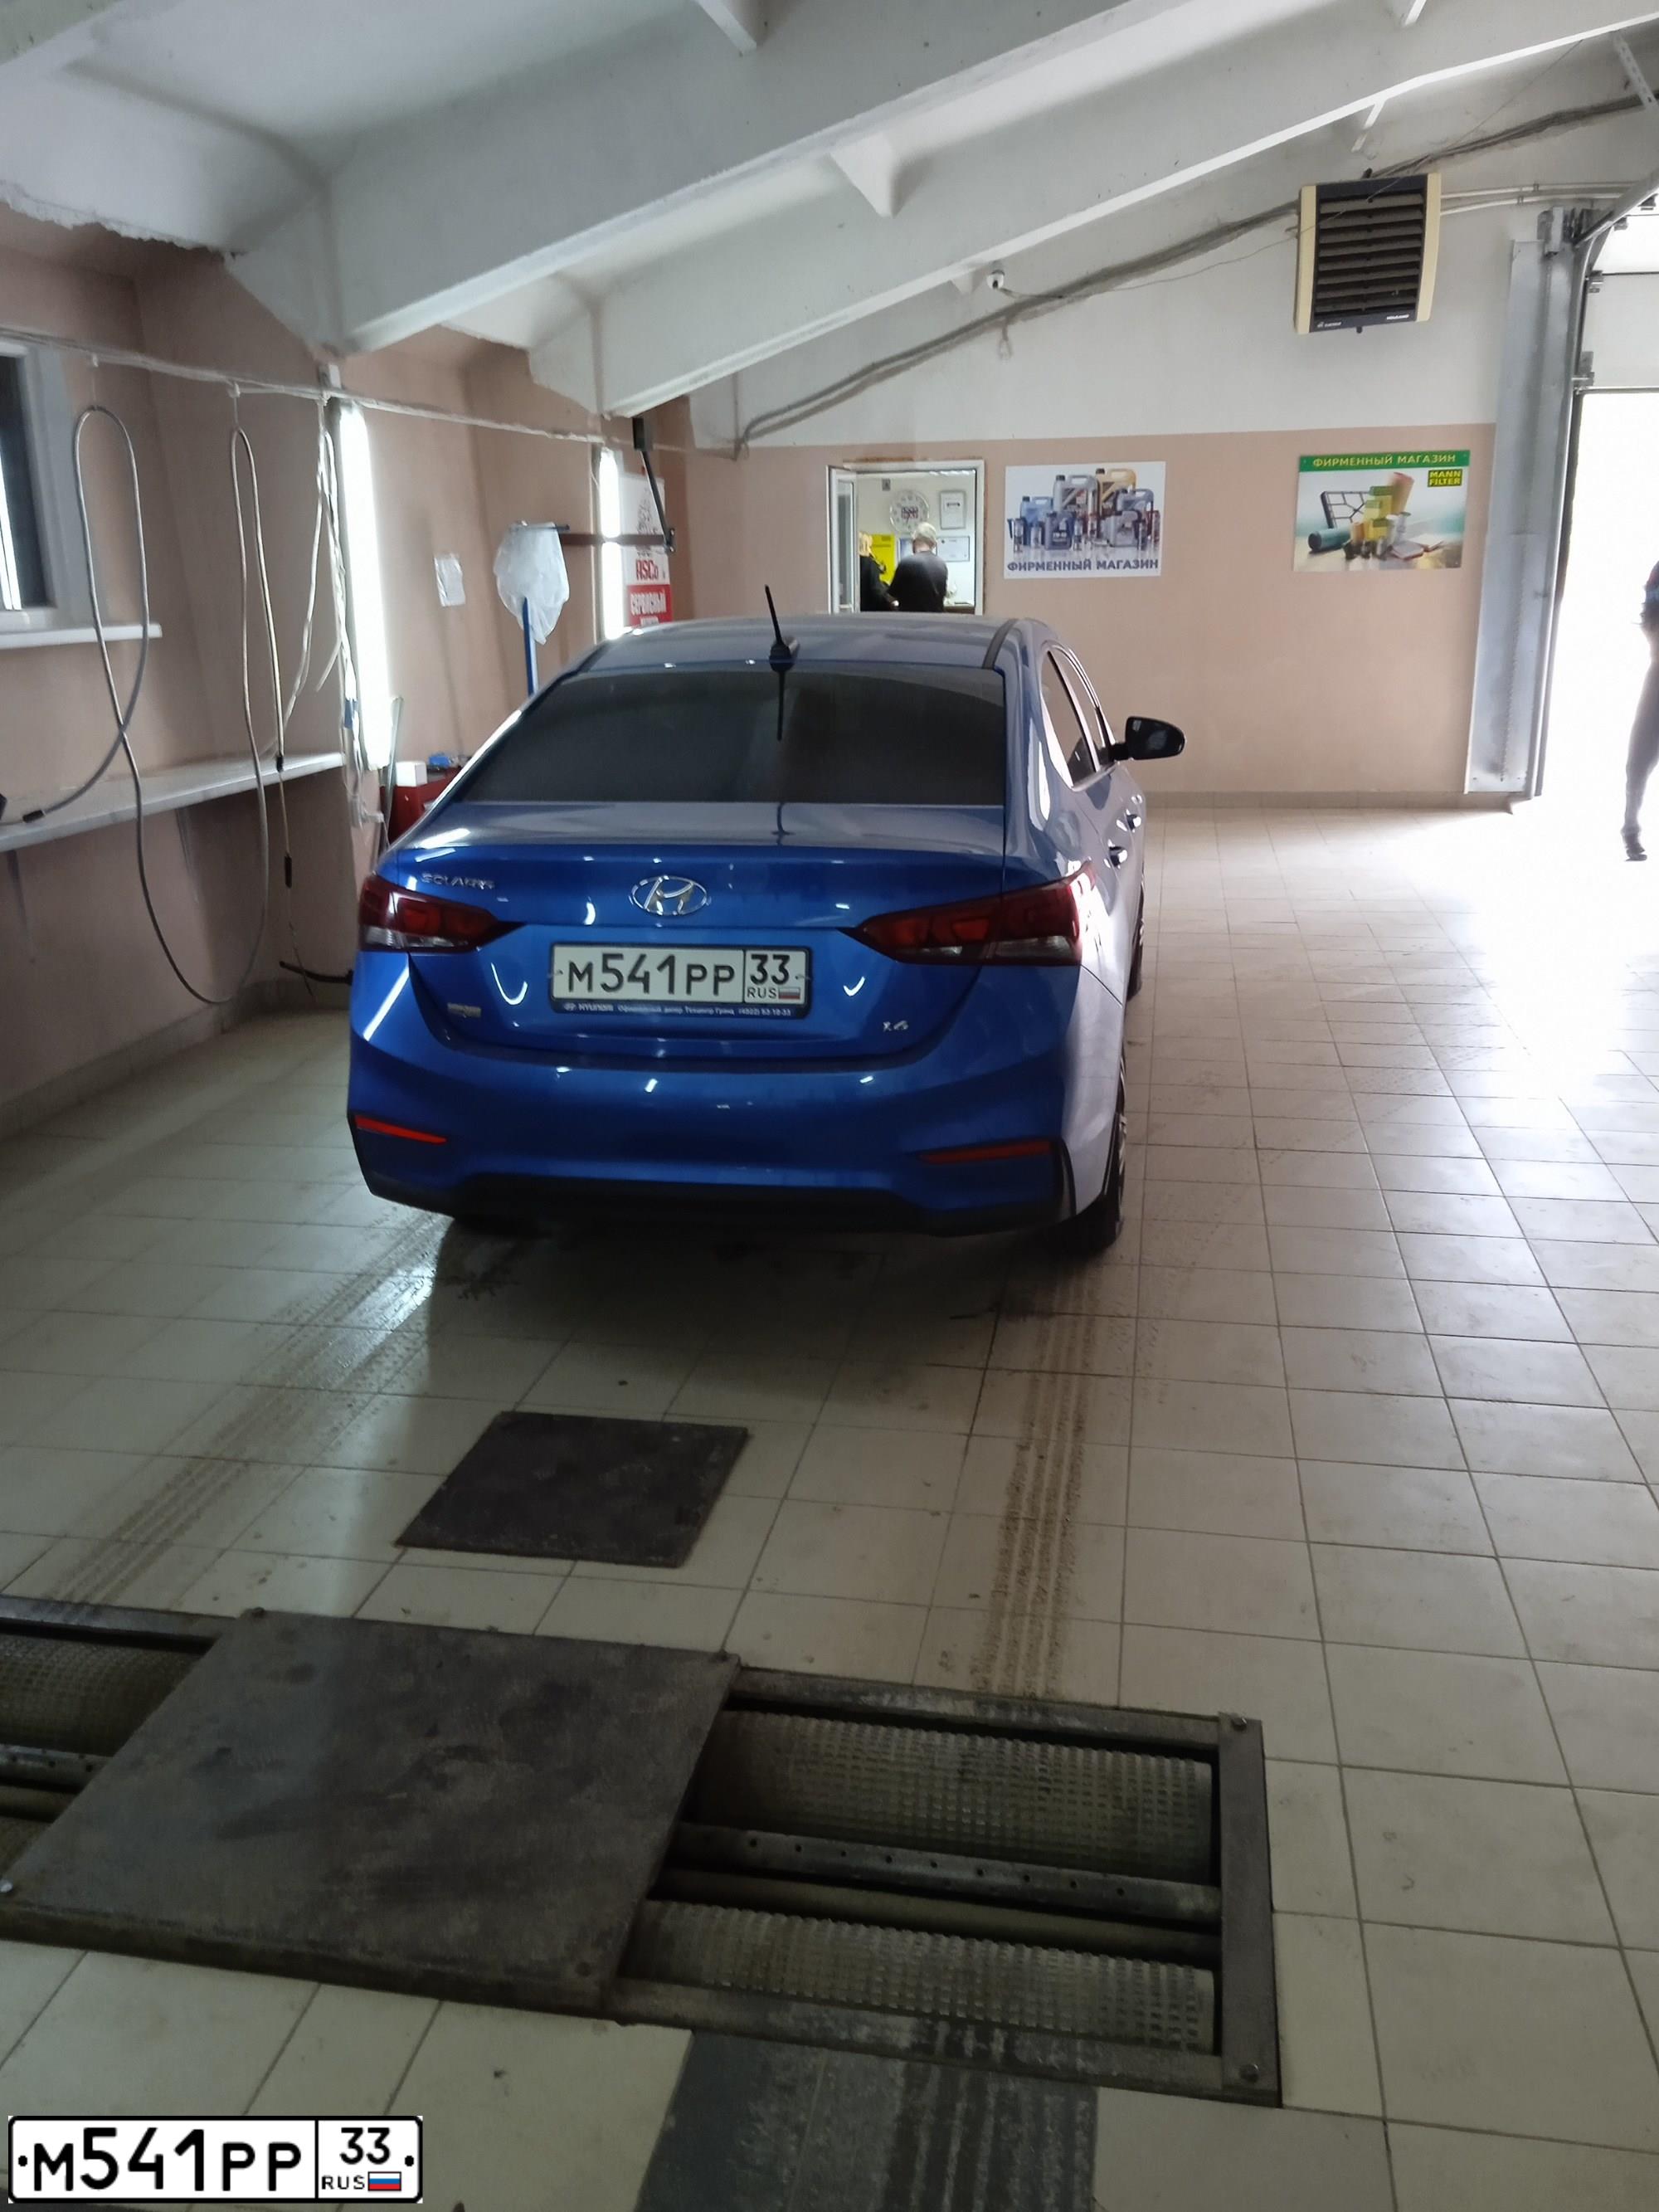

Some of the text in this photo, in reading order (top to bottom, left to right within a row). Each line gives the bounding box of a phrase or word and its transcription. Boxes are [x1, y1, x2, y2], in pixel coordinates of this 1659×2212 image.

[1313, 454, 1456, 467] ФИРМЕННЫЙ МАГАЗИН
[1429, 470, 1462, 478] MANN
[1428, 477, 1461, 486] FILTER
[1007, 558, 1159, 572] ФИРМЕННЫЙ МАГАЗИН
[750, 954, 791, 986] 33
[747, 987, 777, 1000] RUS
